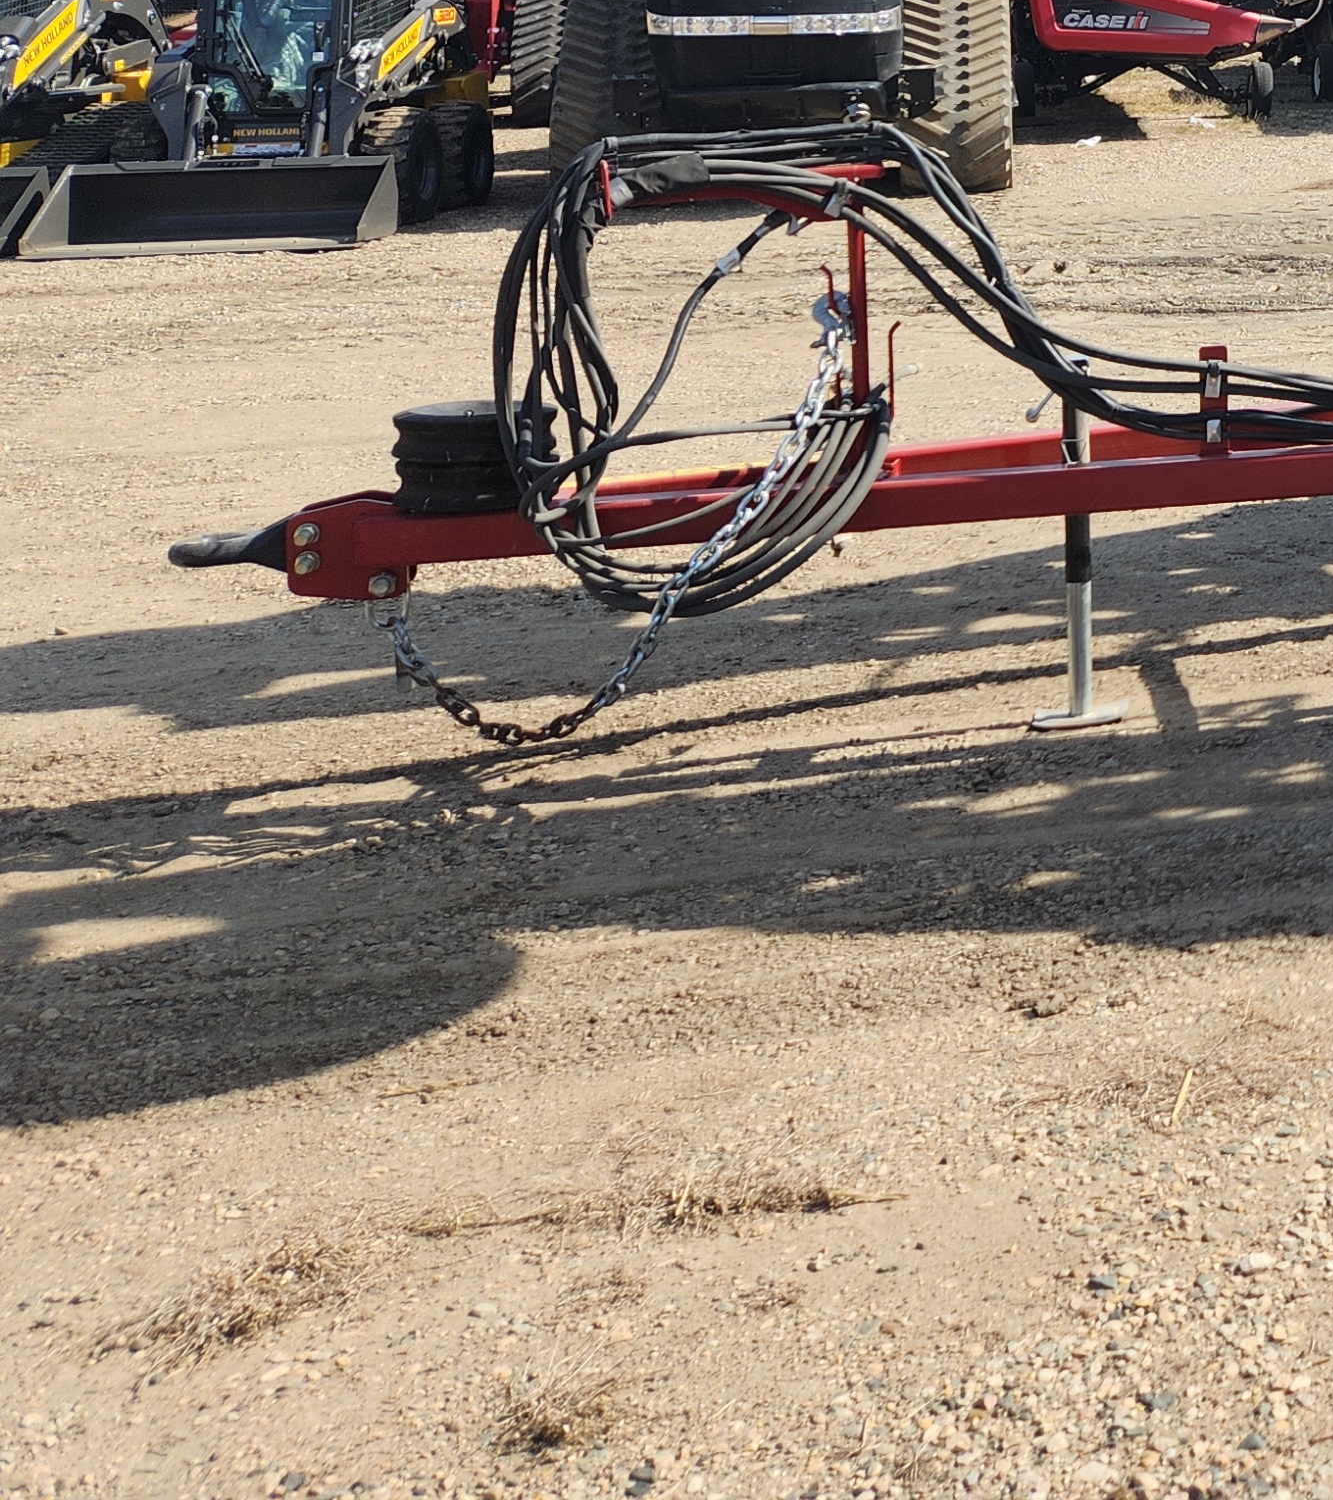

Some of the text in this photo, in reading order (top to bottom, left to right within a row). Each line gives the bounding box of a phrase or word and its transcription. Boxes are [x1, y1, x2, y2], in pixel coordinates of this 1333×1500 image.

[1063, 13, 1126, 29] CASE
[22, 44, 41, 69] NEW
[40, 12, 74, 51] HOLLAND
[233, 127, 300, 138] NEW HOLLAN
